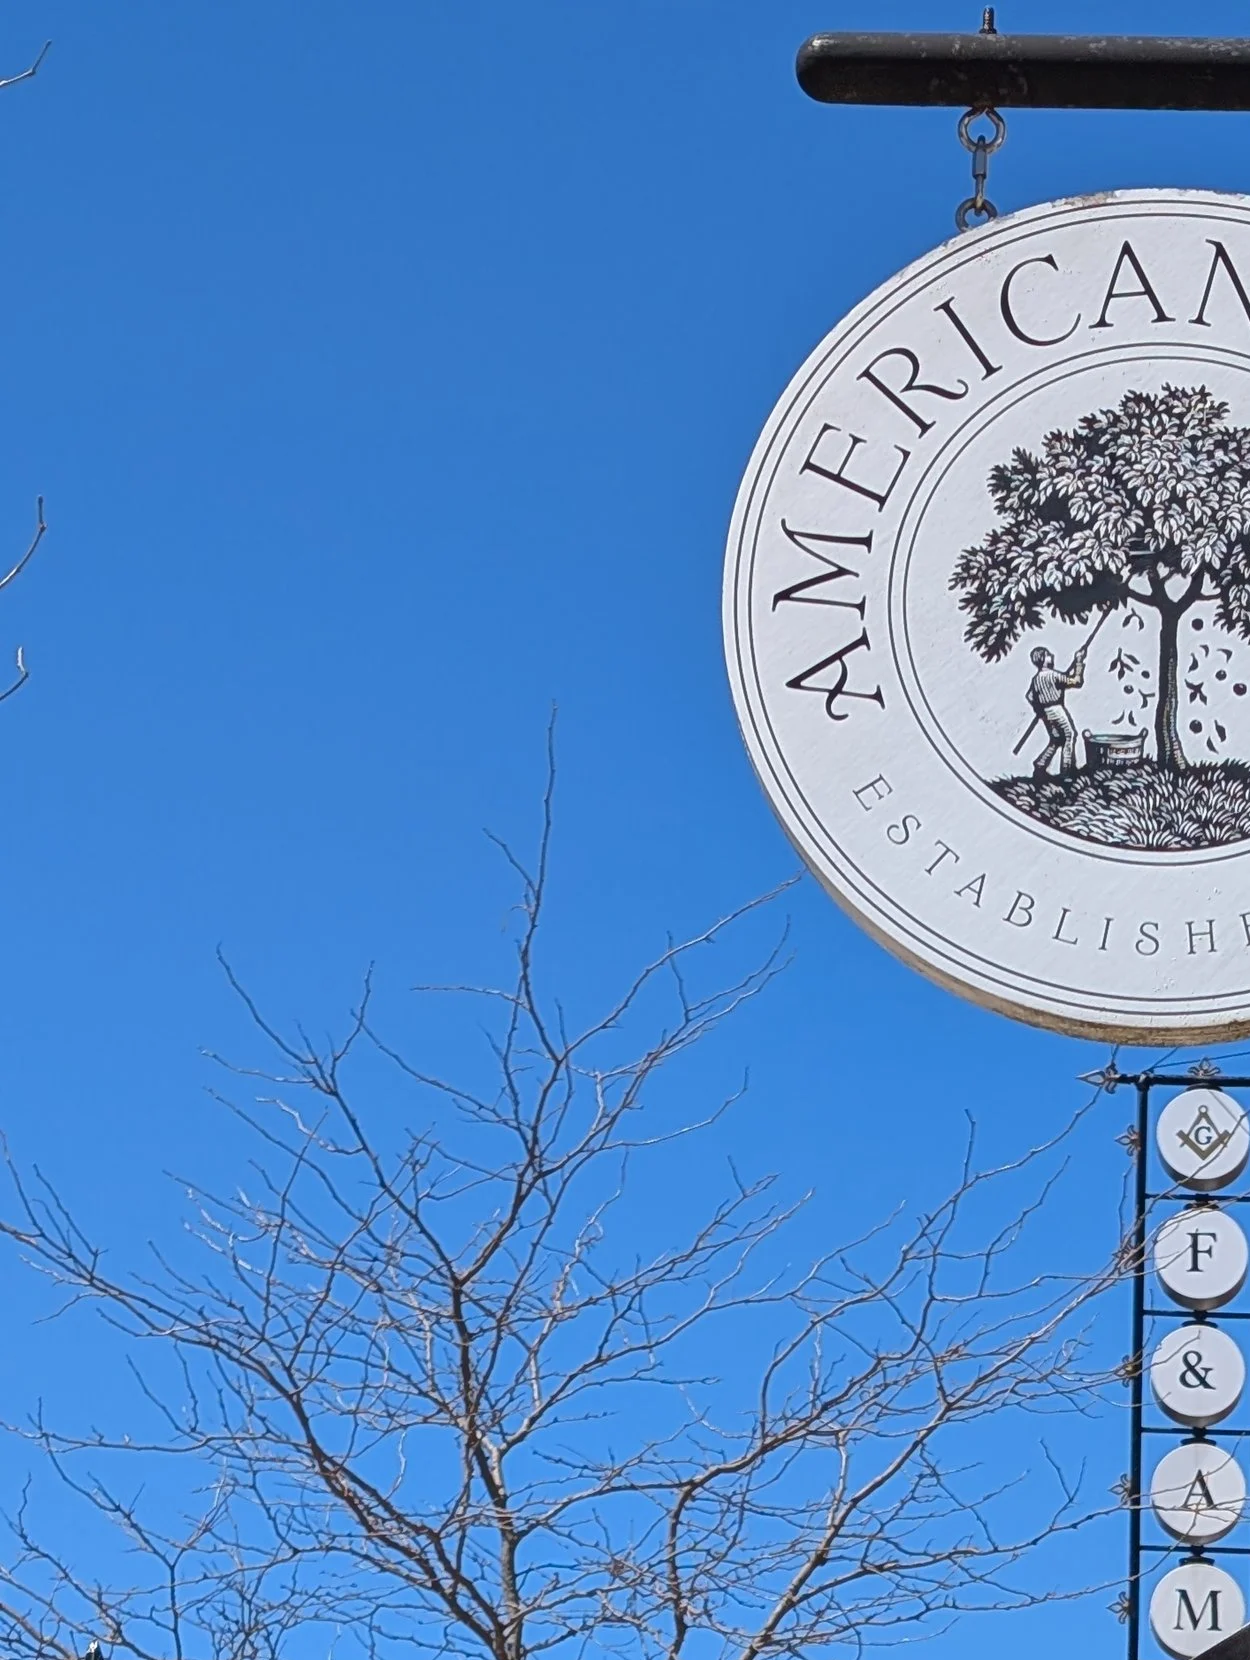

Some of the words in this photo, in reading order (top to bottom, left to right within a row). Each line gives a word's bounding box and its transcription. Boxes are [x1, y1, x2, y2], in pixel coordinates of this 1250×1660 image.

[1195, 1126, 1212, 1145] G
[1187, 1233, 1217, 1272] F
[1179, 1351, 1215, 1390] &
[1183, 1469, 1215, 1510] A
[1174, 1589, 1222, 1631] M
